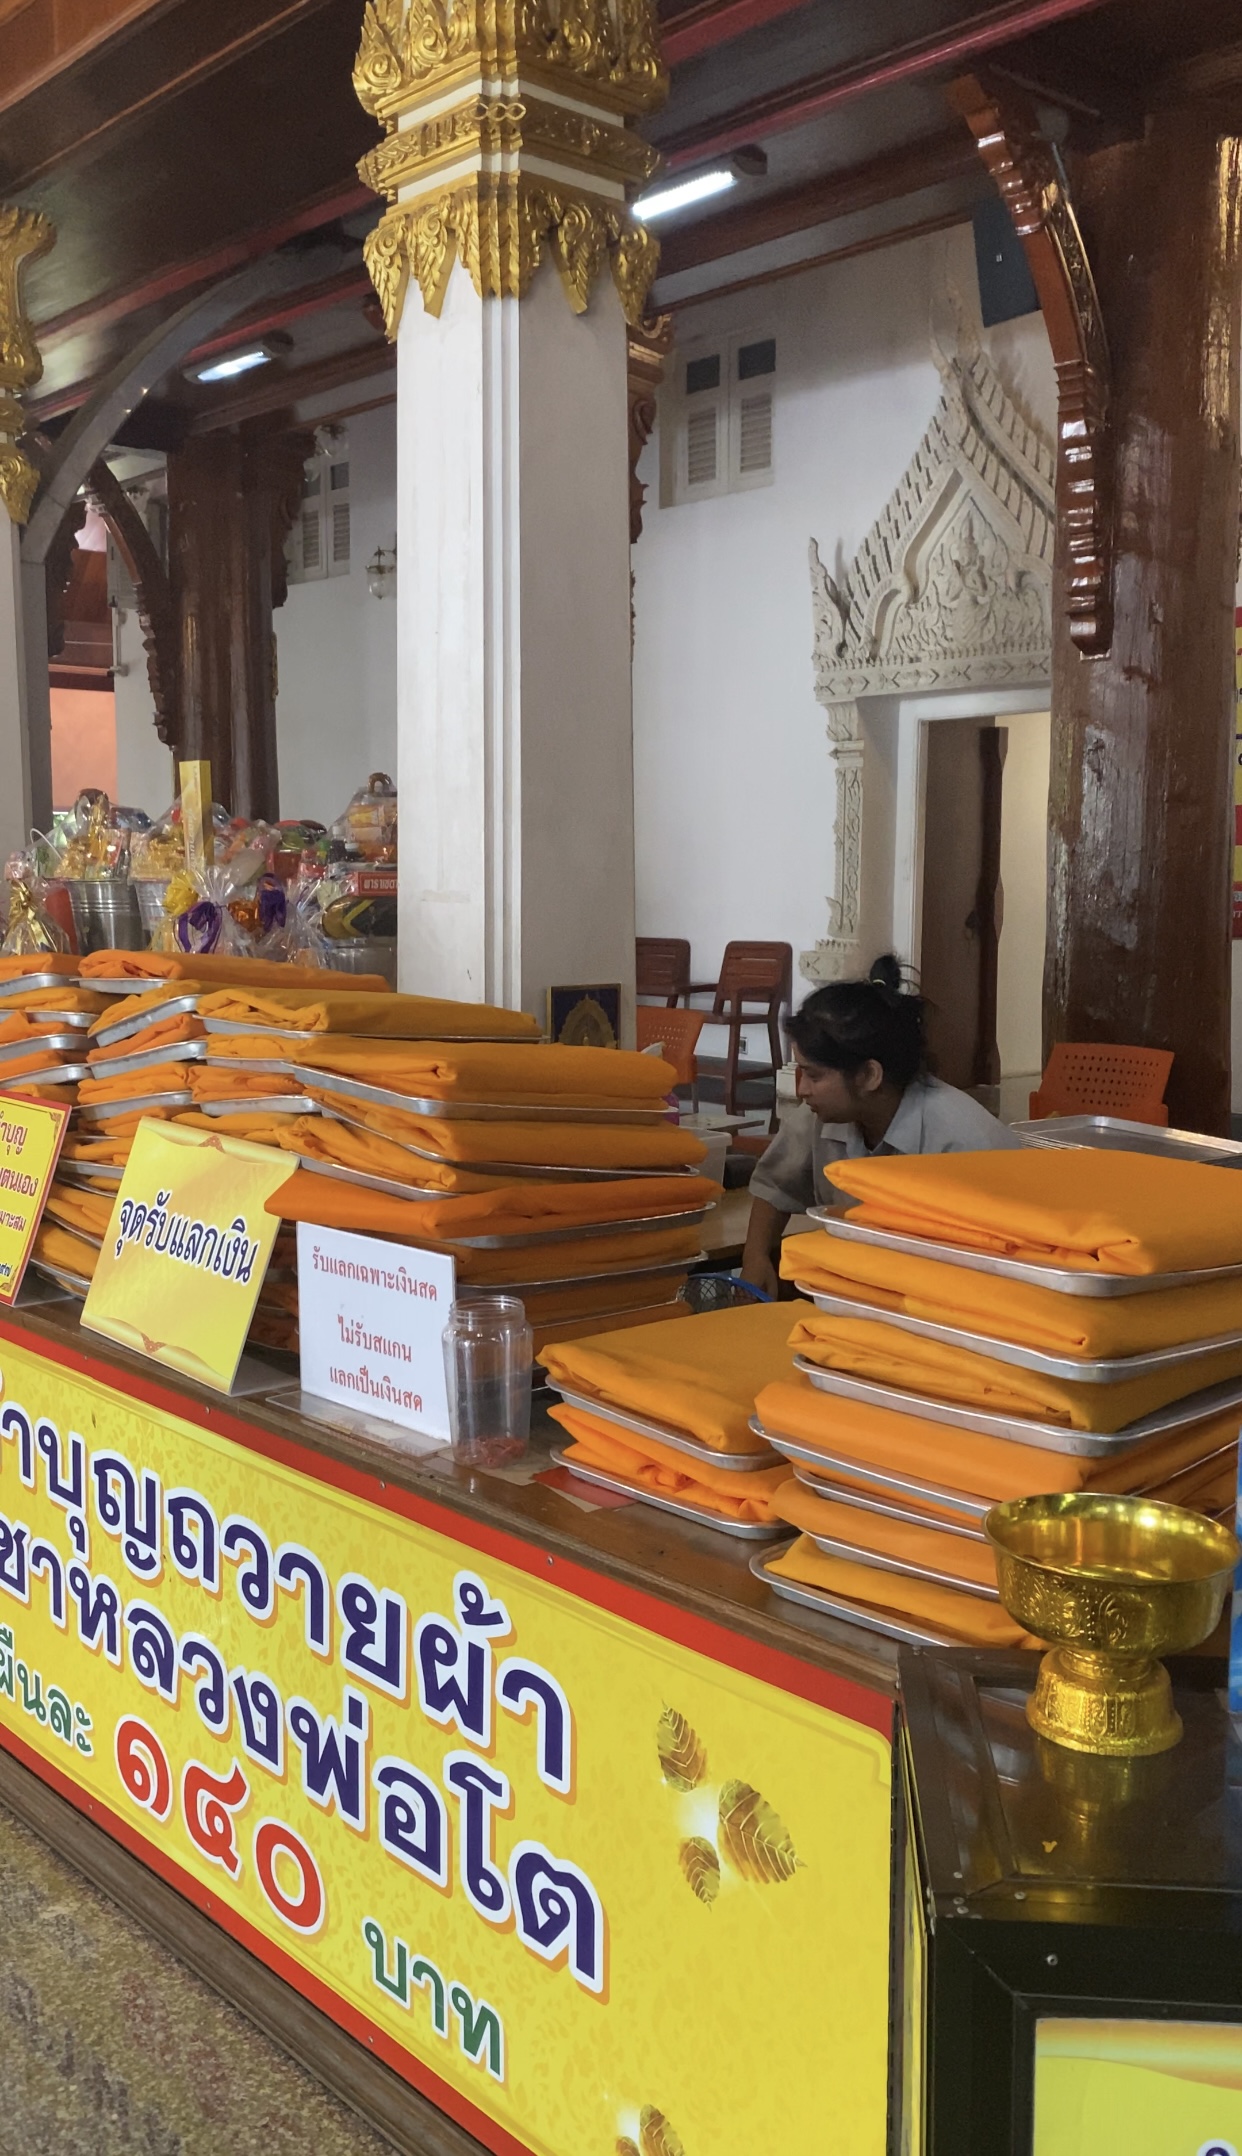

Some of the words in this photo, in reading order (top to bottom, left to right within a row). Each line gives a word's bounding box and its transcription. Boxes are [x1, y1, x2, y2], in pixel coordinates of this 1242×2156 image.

[116, 1191, 259, 1284] จุดรับแลกเงิน
[312, 1246, 438, 1302] รับแลกเฉพาะเงินสด
[337, 1313, 412, 1363] ไม่รับสแกน
[330, 1365, 423, 1413] แลกเป็นเงินสด
[115, 1718, 324, 1930] ๑๔๐
[363, 1920, 502, 2078] บาท
